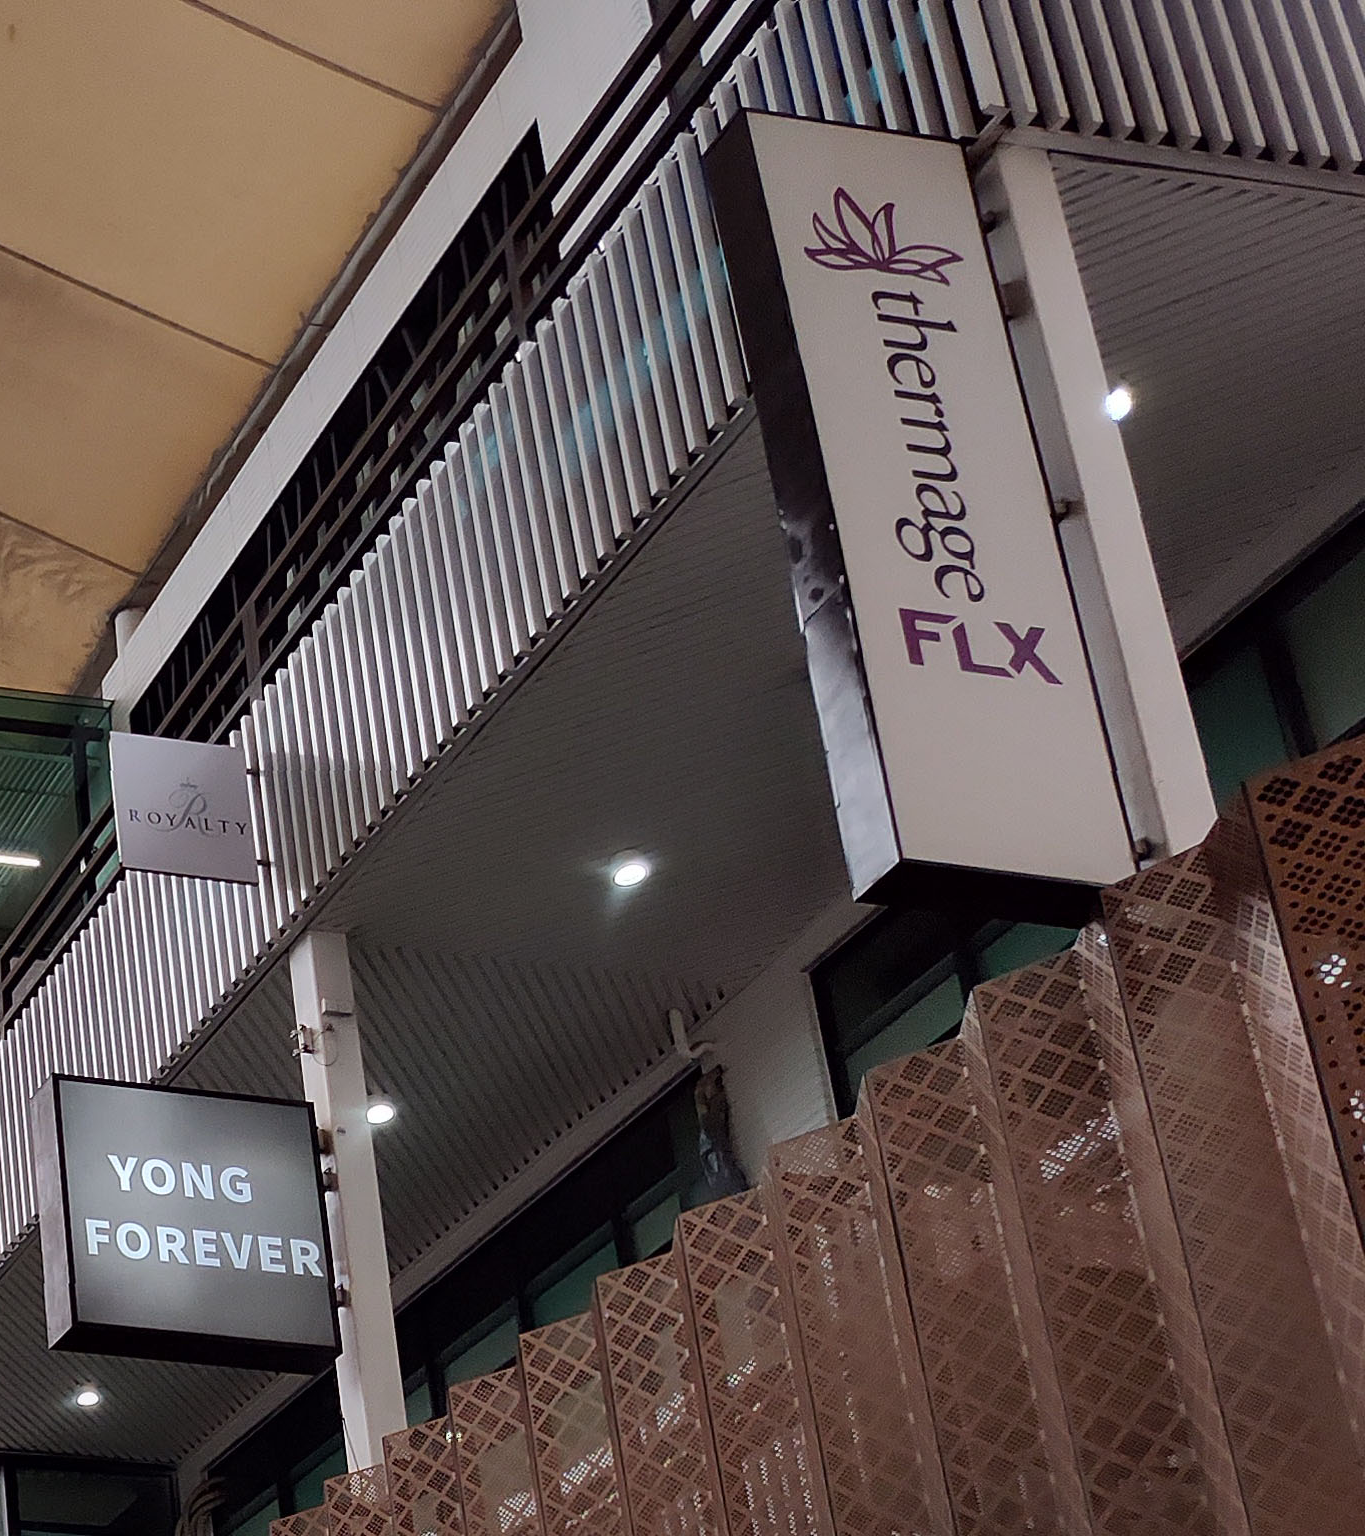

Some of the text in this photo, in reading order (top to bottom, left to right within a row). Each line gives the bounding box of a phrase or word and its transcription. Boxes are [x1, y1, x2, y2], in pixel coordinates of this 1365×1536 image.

[871, 289, 985, 604] thermage
[898, 607, 1063, 686] FLX
[128, 806, 249, 837] ROYALTY
[107, 1153, 253, 1204] YONG
[84, 1218, 325, 1279] FOREVER
